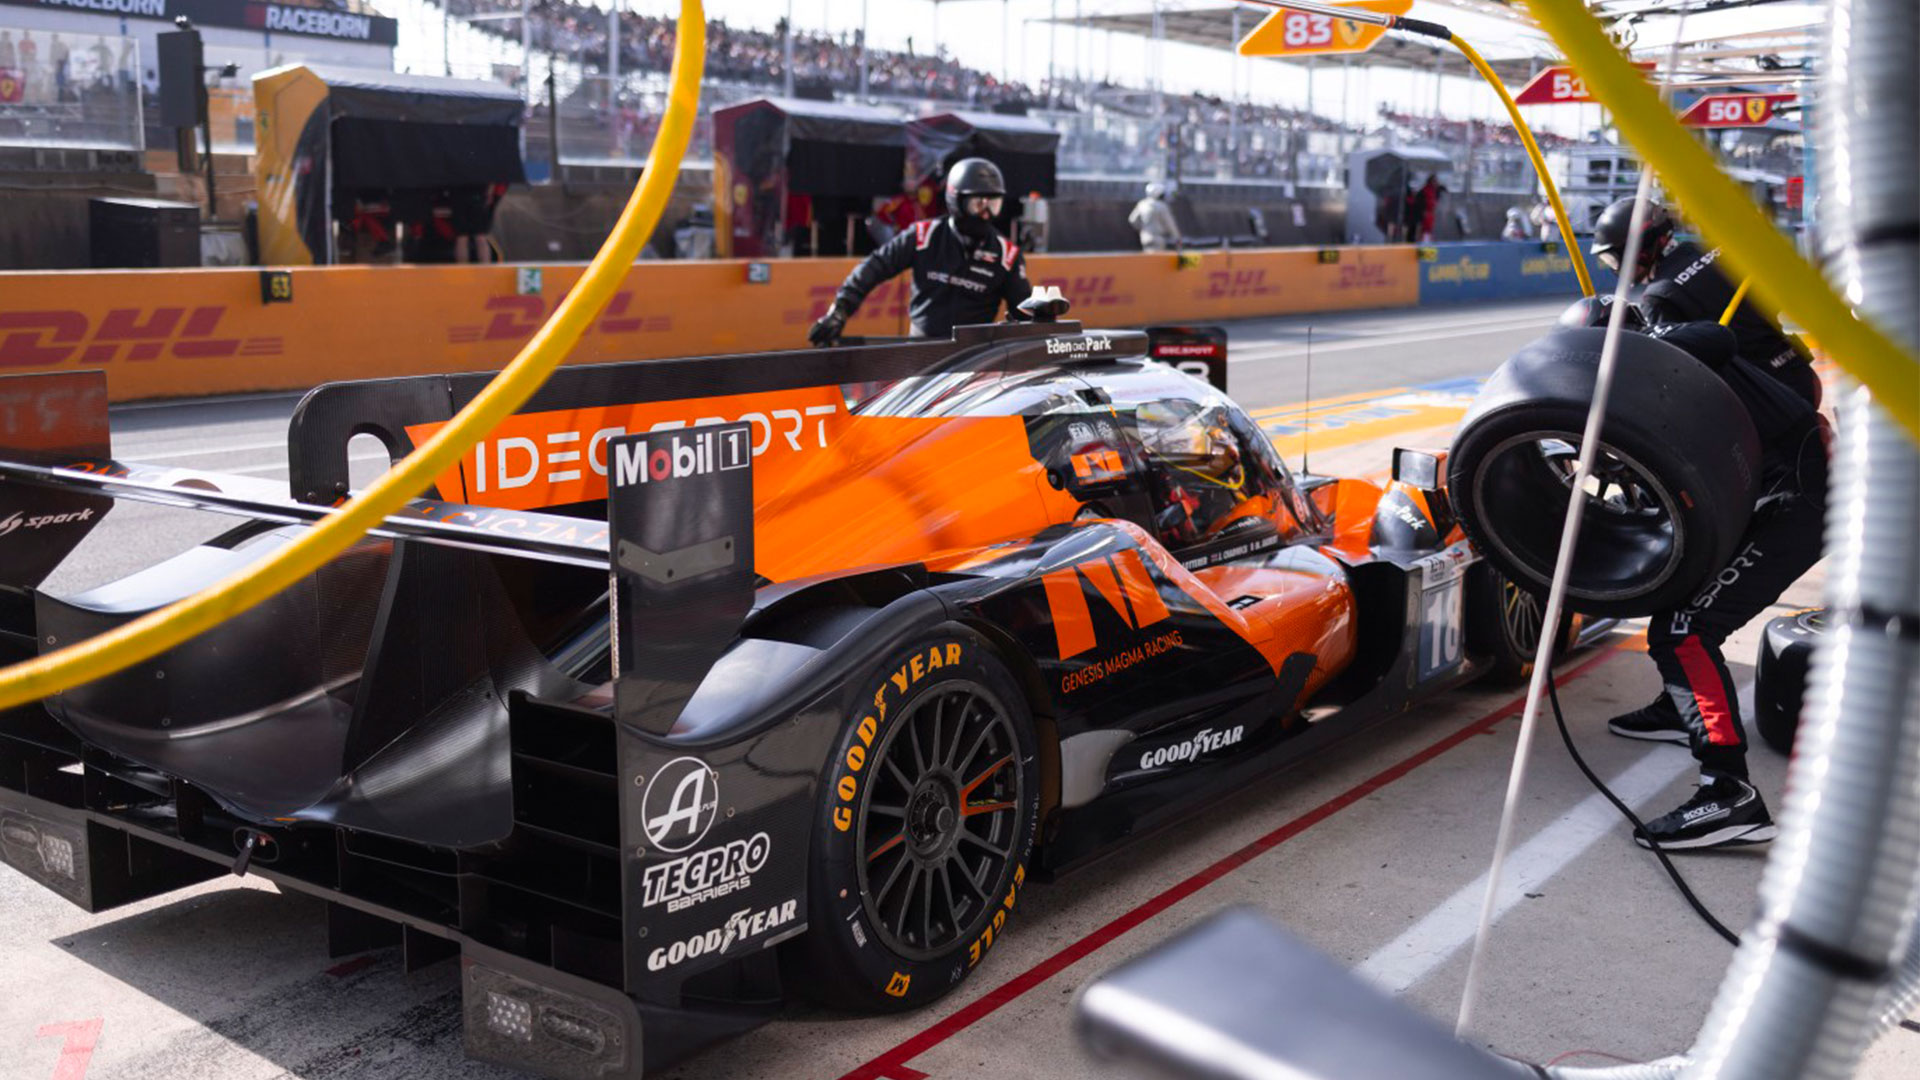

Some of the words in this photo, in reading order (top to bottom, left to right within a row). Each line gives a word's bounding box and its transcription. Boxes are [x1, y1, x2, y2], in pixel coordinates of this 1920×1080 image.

[265, 5, 371, 39] RACEBORN
[1285, 14, 1332, 46] 83
[1552, 74, 1590, 98] 51
[1708, 102, 1742, 121] 50
[1207, 269, 1269, 298] DHL
[1673, 260, 1705, 285] IDEC
[484, 290, 643, 341] DL
[1045, 338, 1072, 354] Eden
[1086, 335, 1112, 352] Park
[475, 427, 626, 493] IDEC
[649, 404, 837, 457] ORT
[615, 432, 714, 488] Mobil
[24, 507, 95, 529] spark
[1691, 541, 1763, 609] SPORT
[1427, 584, 1462, 670] 18
[1061, 662, 1104, 693] GENESIS
[1104, 648, 1146, 675] MAGMA
[1146, 629, 1184, 659] RACING
[833, 642, 962, 833] GOODYEAR
[1140, 724, 1244, 770] GOODYEAR
[642, 831, 771, 908] TECPRO
[647, 899, 798, 972] GOODYEAR
[967, 862, 1027, 969] EAGLE
